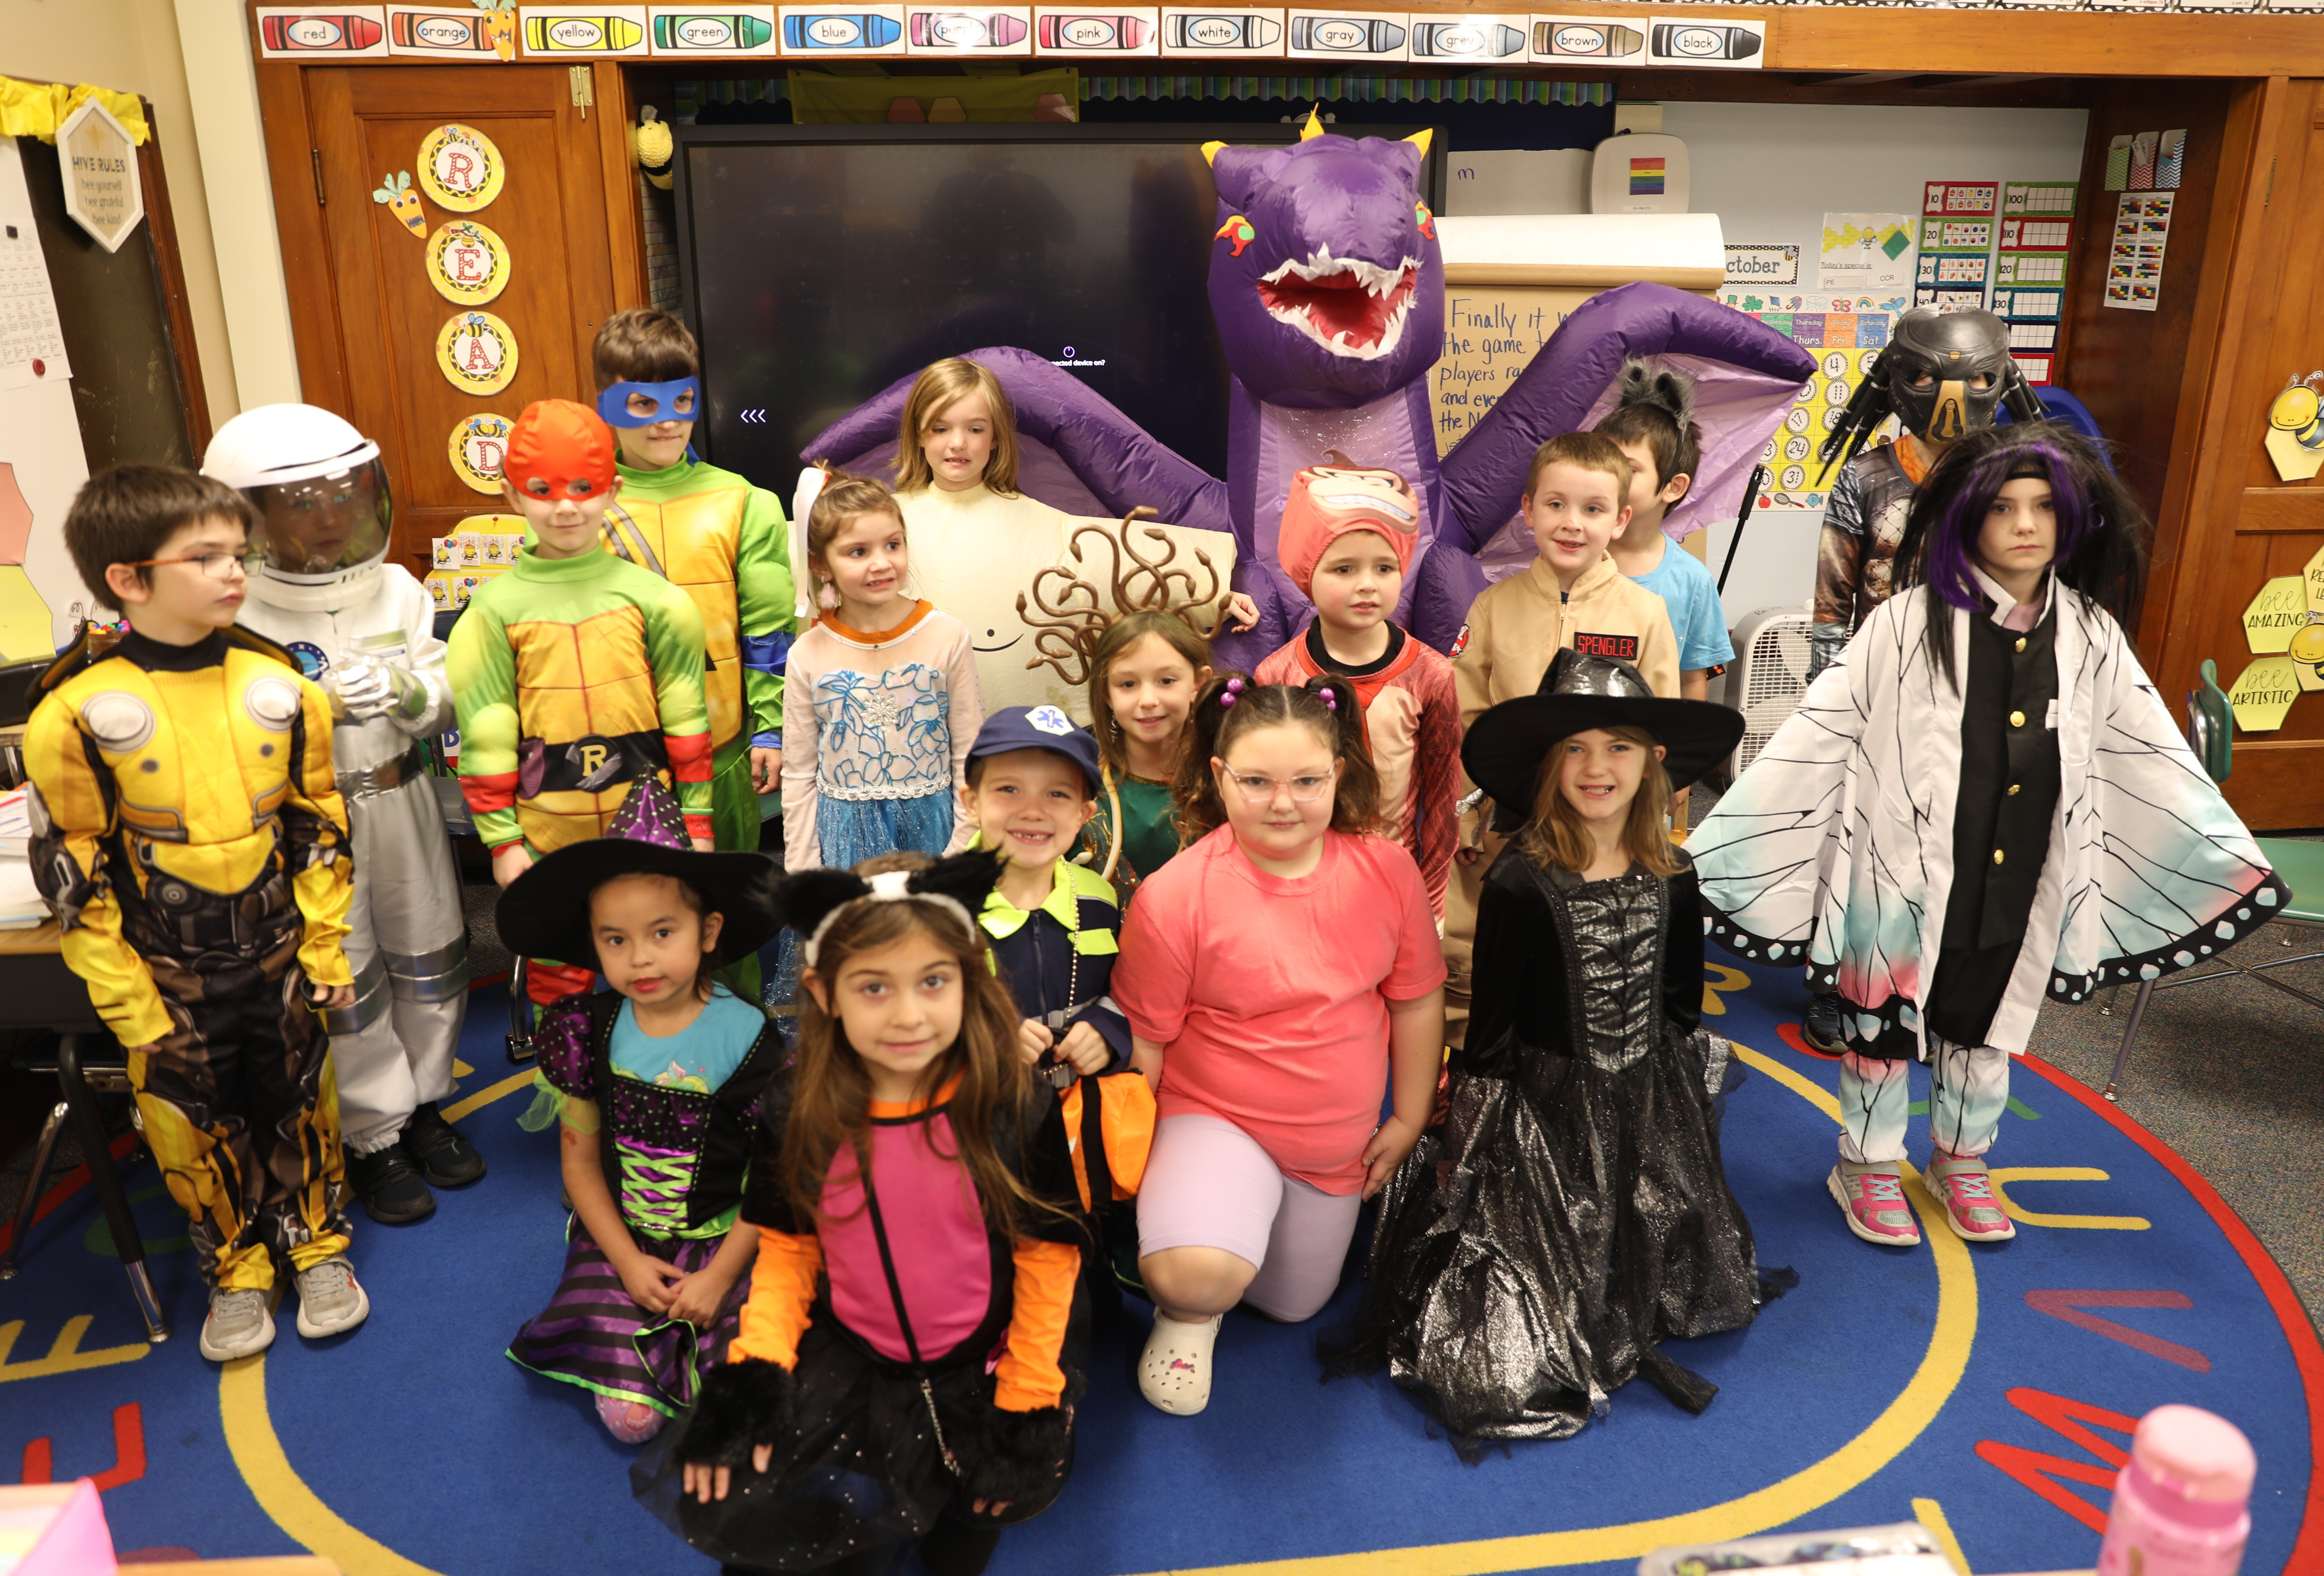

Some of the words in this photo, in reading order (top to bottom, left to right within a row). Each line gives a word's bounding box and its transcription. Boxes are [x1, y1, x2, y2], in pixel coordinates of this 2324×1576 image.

[304, 26, 326, 39] red
[421, 27, 466, 40] orange
[557, 24, 595, 40] yellow
[687, 27, 724, 40] green
[822, 25, 847, 37] blue
[1077, 26, 1100, 41] pink
[1198, 25, 1231, 37] white
[1326, 31, 1354, 43] gray
[1446, 36, 1474, 48] grey
[1561, 33, 1598, 47] brown
[1684, 35, 1713, 48] black
[72, 156, 95, 171] HIVE
[97, 158, 126, 173] RULES
[1458, 168, 1474, 180] m
[82, 178, 95, 190] bee
[96, 180, 123, 194] yourself
[85, 195, 98, 207] bee
[1931, 194, 1939, 204] 10
[2009, 194, 2023, 204] 100
[93, 213, 105, 225] bee
[106, 214, 121, 225] kind
[1927, 231, 1937, 239] 20
[2003, 229, 2015, 239] 110
[1726, 255, 1780, 273] ctober
[1921, 266, 1932, 274] 30
[2000, 265, 2012, 274] 120
[1452, 299, 1517, 337] Finally
[1528, 306, 1547, 330] it
[1792, 335, 1822, 344] Thurs.
[1832, 335, 1847, 345] Fri.
[1863, 335, 1880, 345] Sat.
[1442, 331, 1475, 357] the
[1482, 338, 1526, 365] game
[1830, 357, 1840, 372] 4
[1440, 360, 1495, 391] players
[1441, 389, 1468, 406] and
[1833, 385, 1843, 400] 11
[1438, 409, 1463, 434] the
[1789, 440, 1805, 456] 24
[1786, 471, 1800, 484] 31
[2259, 589, 2302, 611] bee
[2247, 613, 2305, 629] AMAZING
[1577, 635, 1635, 658] SPENGLER
[2245, 667, 2289, 690] bee
[2232, 689, 2293, 706] ARTISTIC
[580, 744, 607, 777] R
